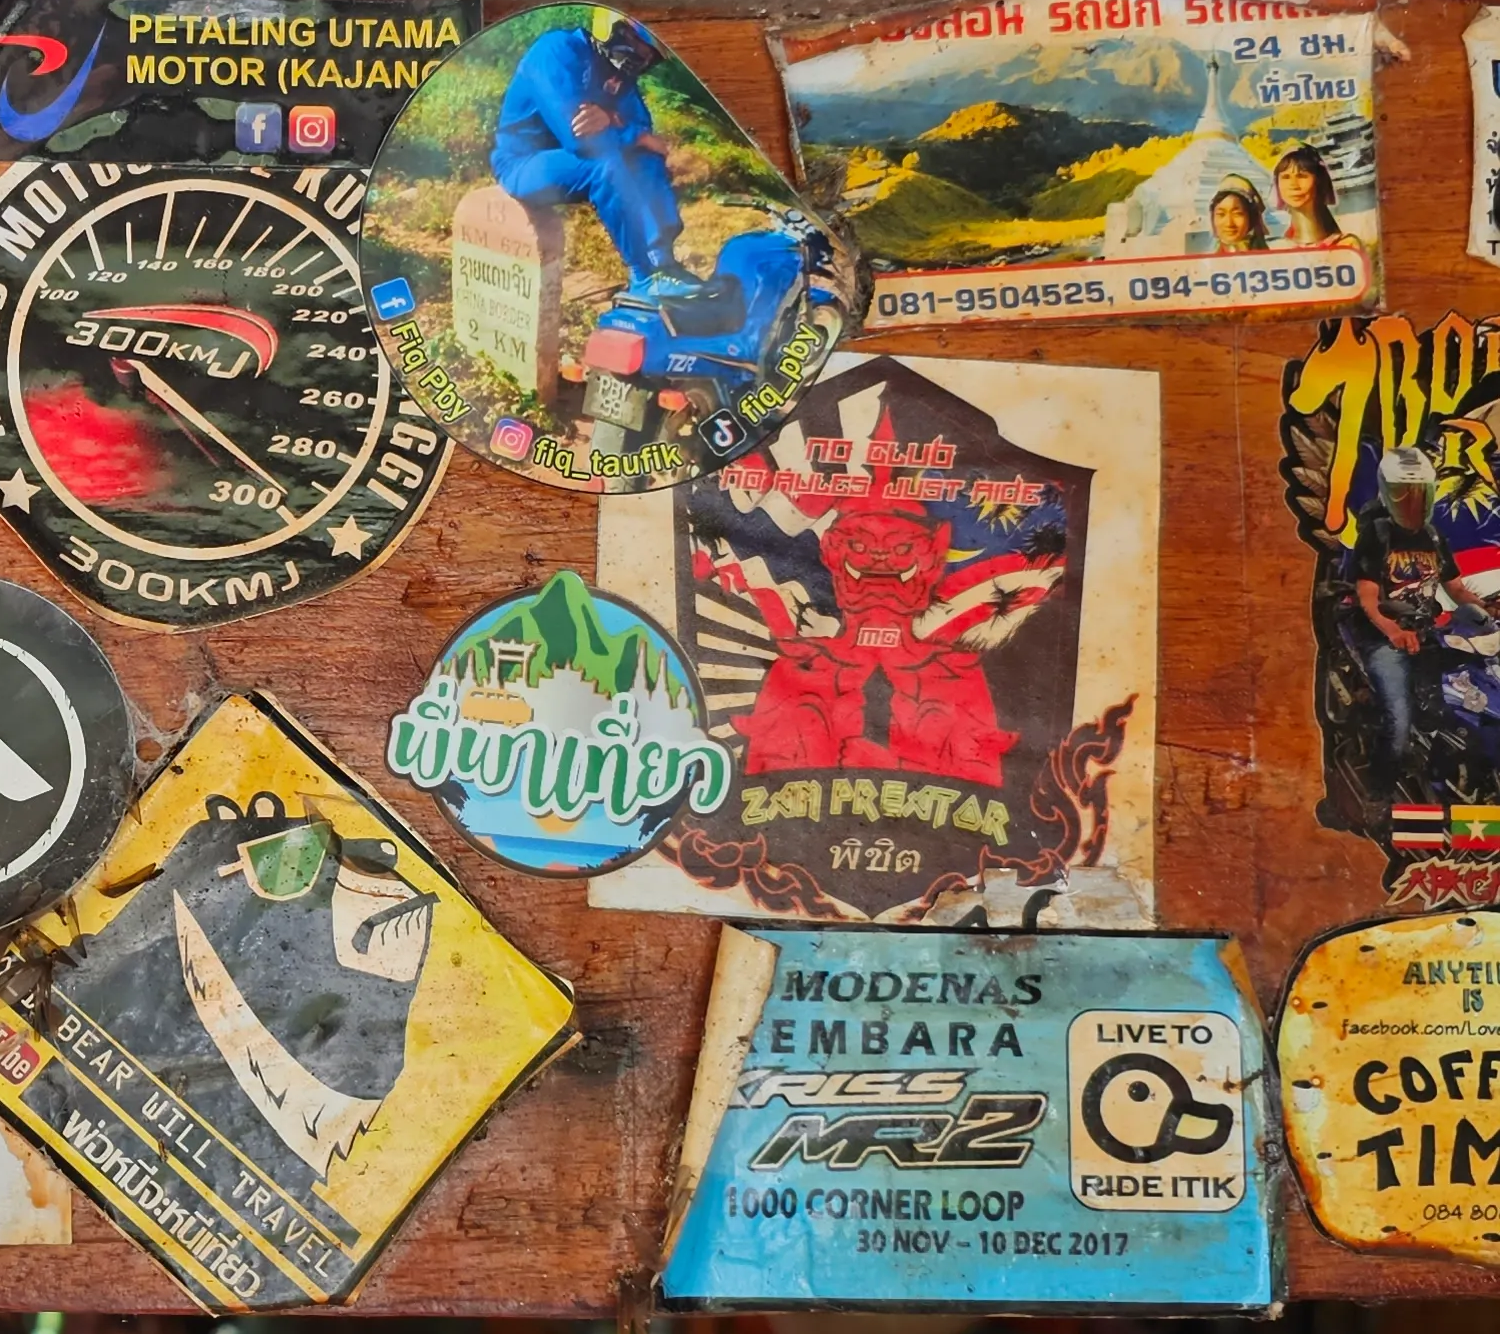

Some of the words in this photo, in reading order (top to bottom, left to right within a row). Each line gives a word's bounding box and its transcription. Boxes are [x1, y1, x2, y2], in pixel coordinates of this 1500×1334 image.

[128, 15, 317, 47] PETALING
[328, 17, 462, 49] UTAMA
[1233, 35, 1281, 61] 24
[125, 55, 264, 88] MOTOR
[136, 257, 179, 272] 140
[191, 255, 234, 271] 160
[87, 269, 128, 284] 120
[1129, 263, 1356, 302] 094-6135050
[39, 286, 80, 302] 100
[270, 282, 325, 298] 200
[291, 308, 349, 324] 220
[307, 344, 368, 363] 240
[469, 319, 479, 341] 2
[494, 329, 528, 362] KM
[390, 320, 427, 373] Fiq
[419, 363, 472, 425] Pby
[666, 353, 697, 373] TZR
[738, 322, 824, 426] fiq_pby
[299, 388, 370, 410] 260
[267, 435, 338, 458] 280
[532, 438, 685, 480] fiq_taufik
[208, 480, 279, 509] 300
[883, 477, 964, 502] JUST
[830, 837, 922, 873] พิชิต
[1403, 960, 1500, 985] ANYTI
[782, 970, 1043, 1007] MODENAS
[1462, 988, 1484, 1013] IS
[748, 1019, 1025, 1058] EMBARA
[1096, 1023, 1167, 1045] LIVE
[1171, 1023, 1213, 1045] TO
[57, 1014, 134, 1090] BEAR
[141, 1091, 211, 1169] WILL
[231, 1171, 335, 1278] TRAVEL
[1081, 1174, 1166, 1198] RIDE
[1171, 1174, 1237, 1200] ITIK
[727, 1186, 797, 1220] 1000
[805, 1188, 932, 1221] CORNER
[941, 1190, 1025, 1222] LOOP
[856, 1228, 887, 1253] 30
[893, 1229, 950, 1255] NOV
[980, 1230, 1006, 1255] 10
[1012, 1230, 1062, 1256] DEC
[1068, 1231, 1129, 1257] 2017
